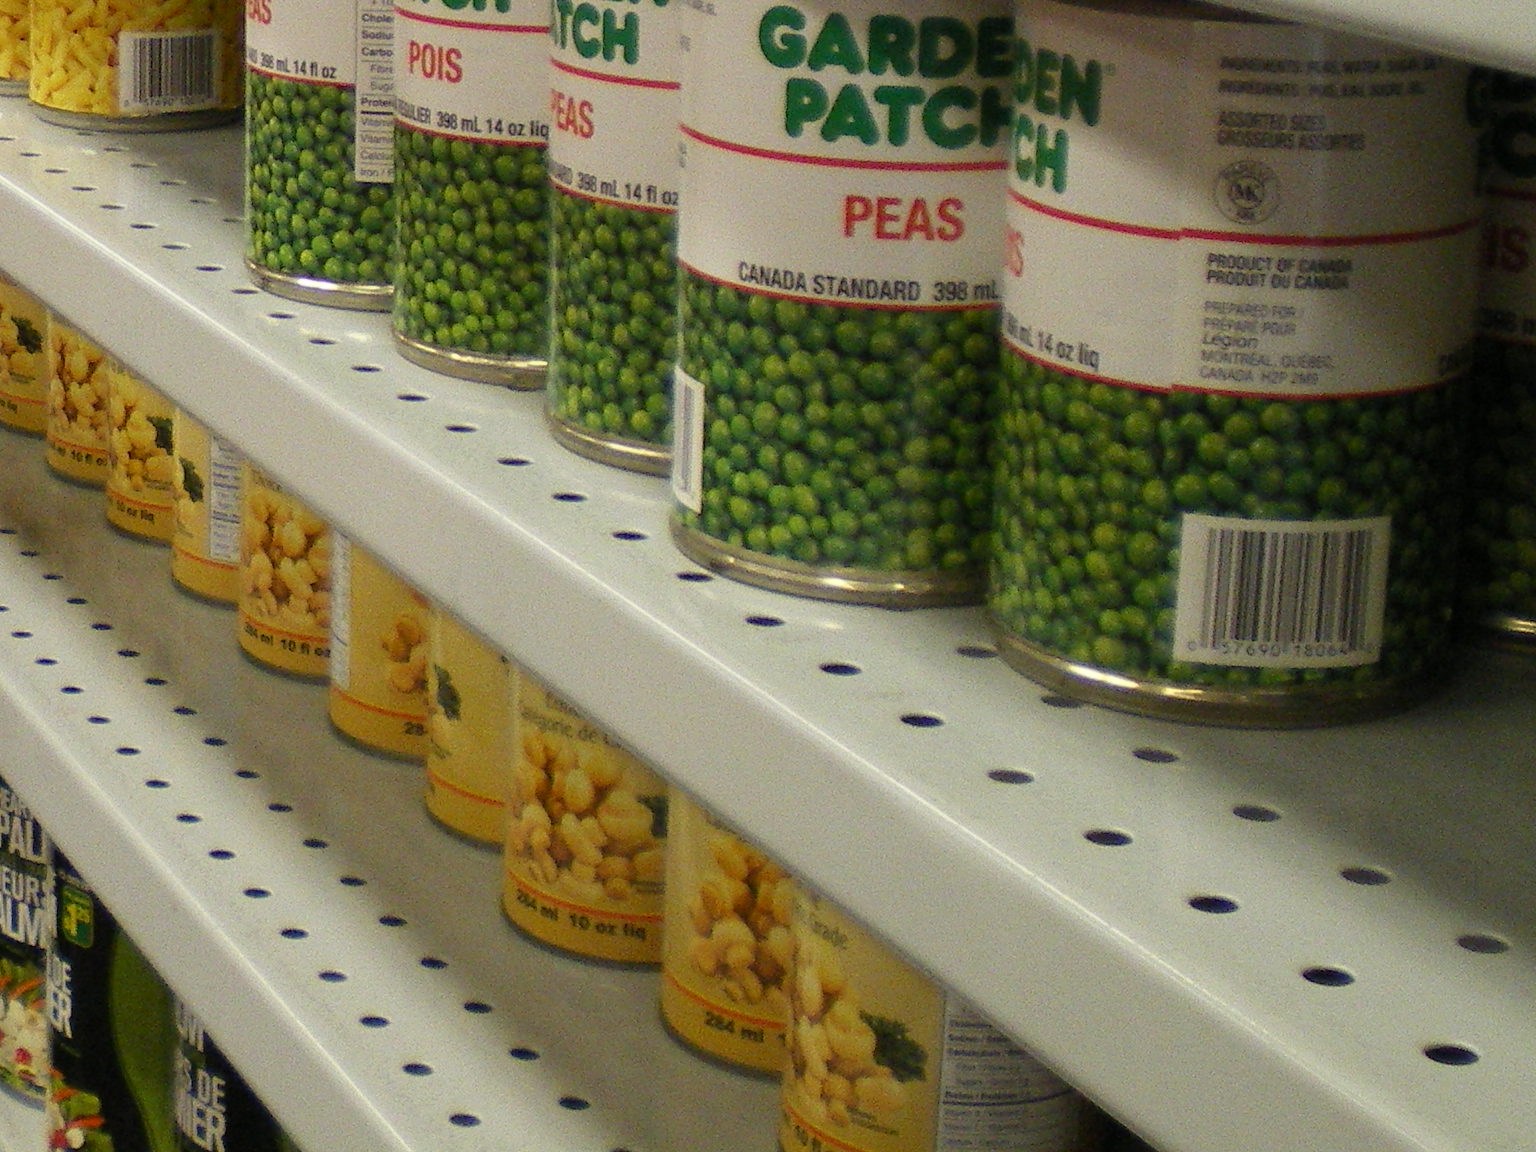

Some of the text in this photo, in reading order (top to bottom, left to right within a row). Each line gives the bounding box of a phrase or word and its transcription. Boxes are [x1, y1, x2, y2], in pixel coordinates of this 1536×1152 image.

[294, 58, 306, 76] 14
[322, 65, 337, 80] oz
[408, 39, 463, 84] POIS
[437, 110, 458, 130] 398
[461, 114, 481, 135] mL
[486, 117, 503, 136] 14
[508, 123, 525, 137] oz
[578, 171, 598, 194] 398
[625, 182, 642, 202] 14
[842, 193, 965, 243] PEAS
[737, 260, 808, 295] CANADA
[813, 274, 921, 302] STANDARD
[933, 281, 969, 302] 398
[569, 912, 590, 931] 10
